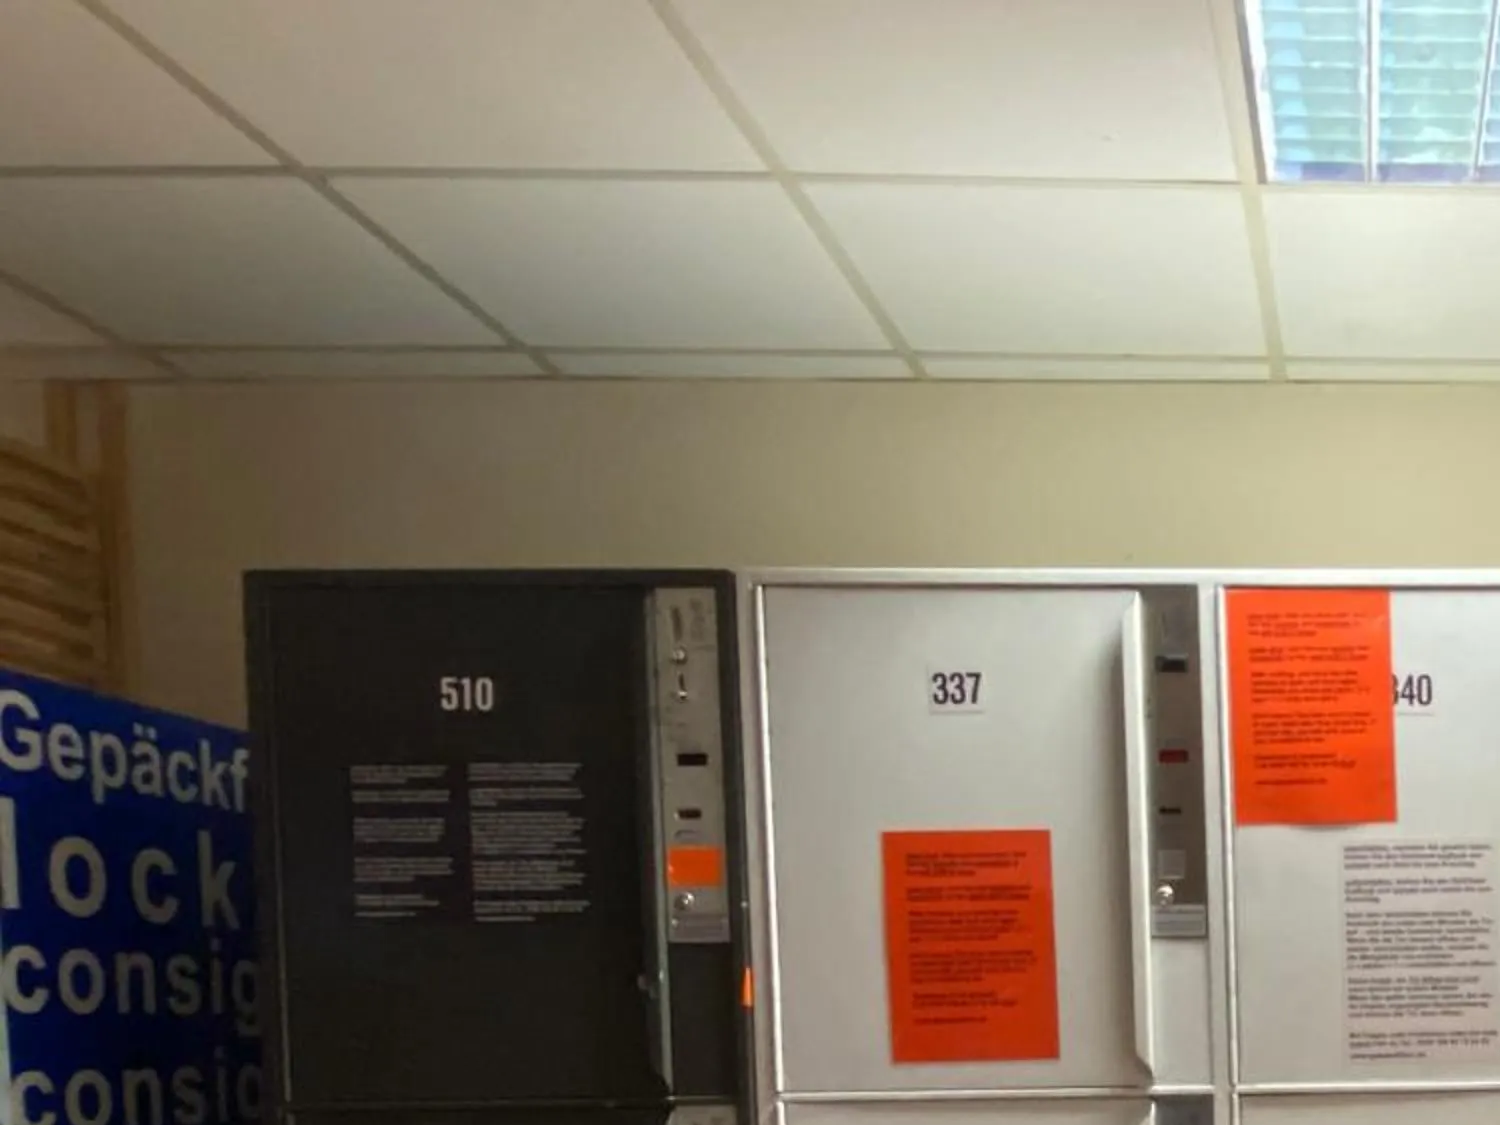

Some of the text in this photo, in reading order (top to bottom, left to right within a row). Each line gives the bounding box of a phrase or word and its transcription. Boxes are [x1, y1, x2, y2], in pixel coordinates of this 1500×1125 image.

[440, 676, 494, 711] 510
[931, 673, 981, 705] 337
[2, 938, 262, 1036] consig
